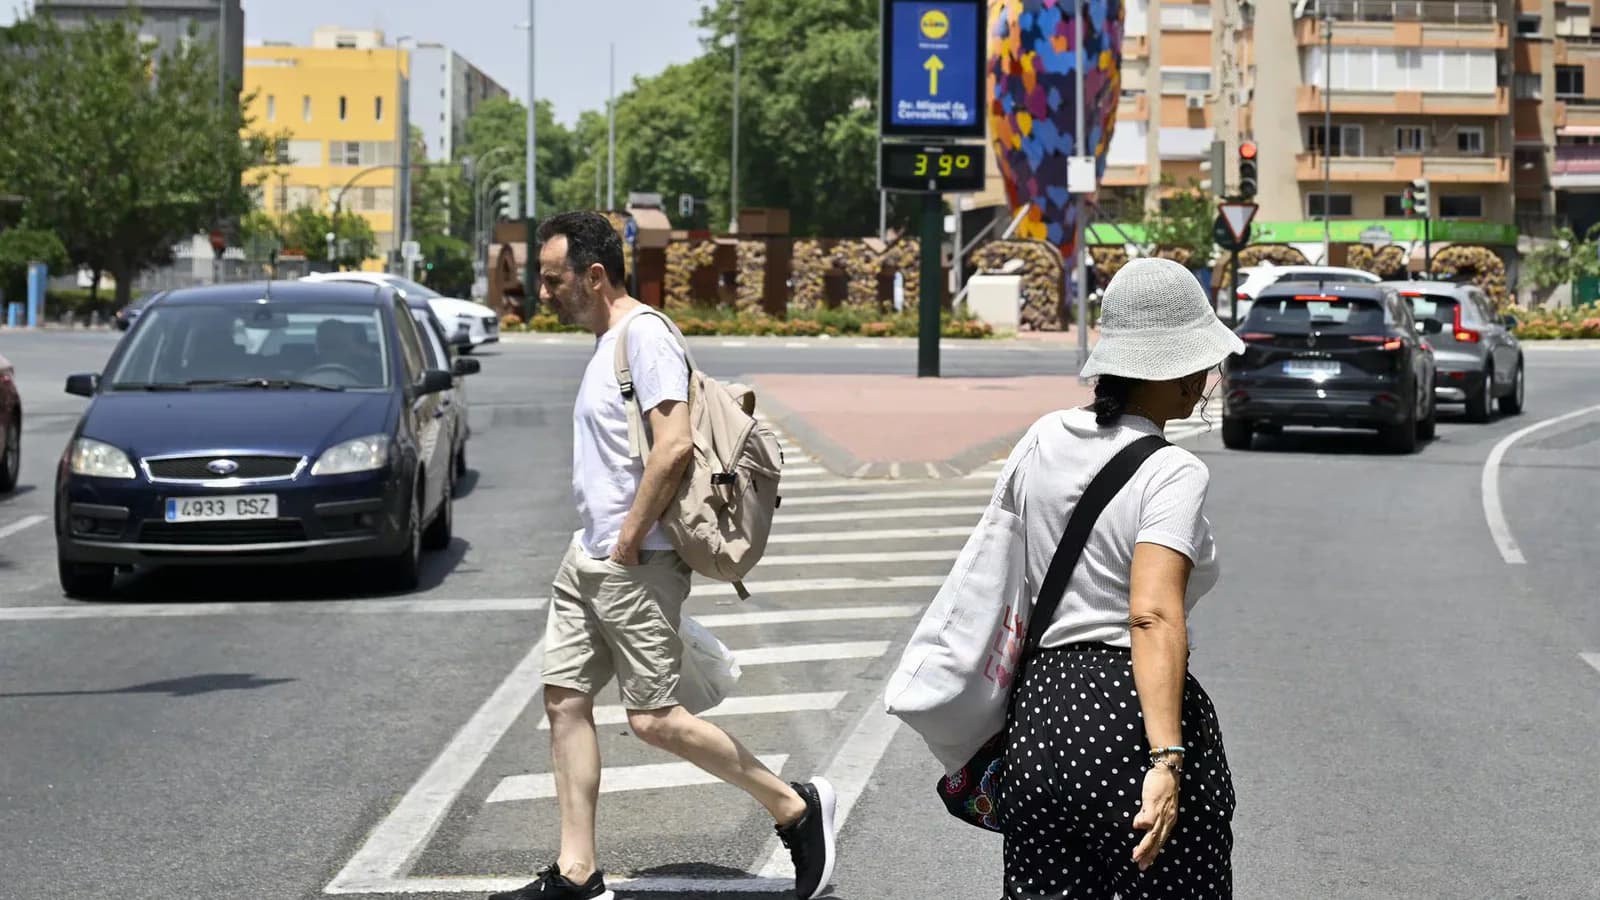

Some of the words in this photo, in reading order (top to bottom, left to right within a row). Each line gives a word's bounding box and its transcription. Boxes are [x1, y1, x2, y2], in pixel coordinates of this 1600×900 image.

[916, 100, 951, 112] Miguel
[953, 101, 966, 109] de
[182, 499, 225, 516] 4933
[236, 498, 269, 516] DSZ
